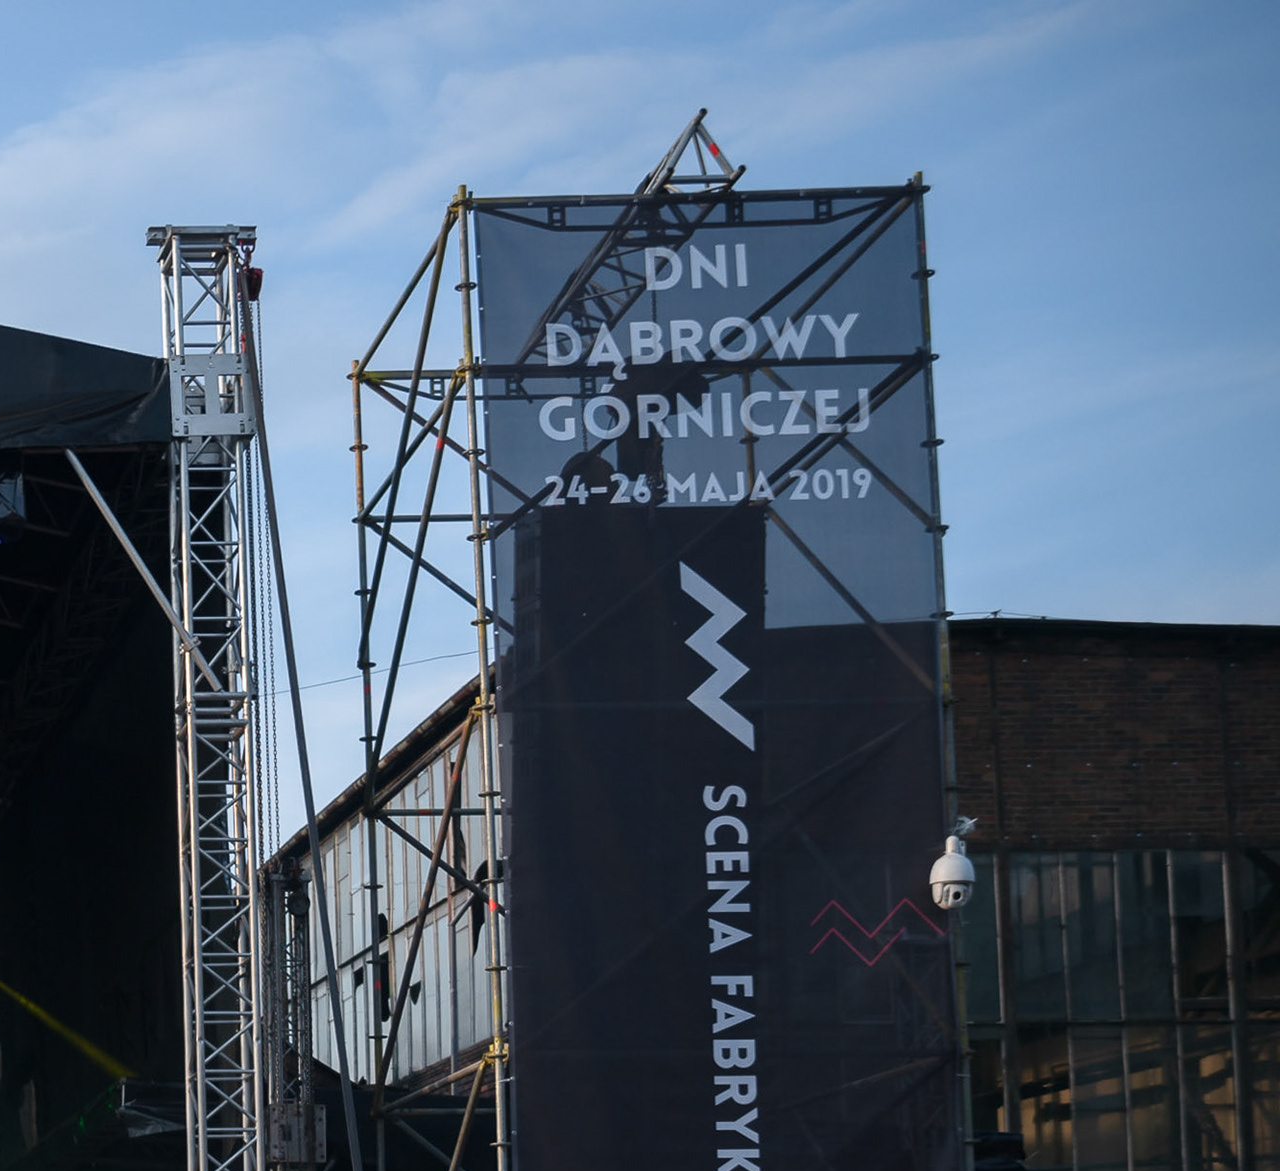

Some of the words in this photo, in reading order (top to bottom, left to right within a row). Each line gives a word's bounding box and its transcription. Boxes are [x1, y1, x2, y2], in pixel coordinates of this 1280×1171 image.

[643, 243, 749, 292] DNI
[545, 313, 860, 381] DĄBROWY
[538, 384, 871, 442] GÓRNICZEJ
[541, 473, 653, 506] 24-26
[666, 470, 775, 504] MAJA
[788, 468, 873, 501] 2019
[702, 784, 752, 954] SCENA
